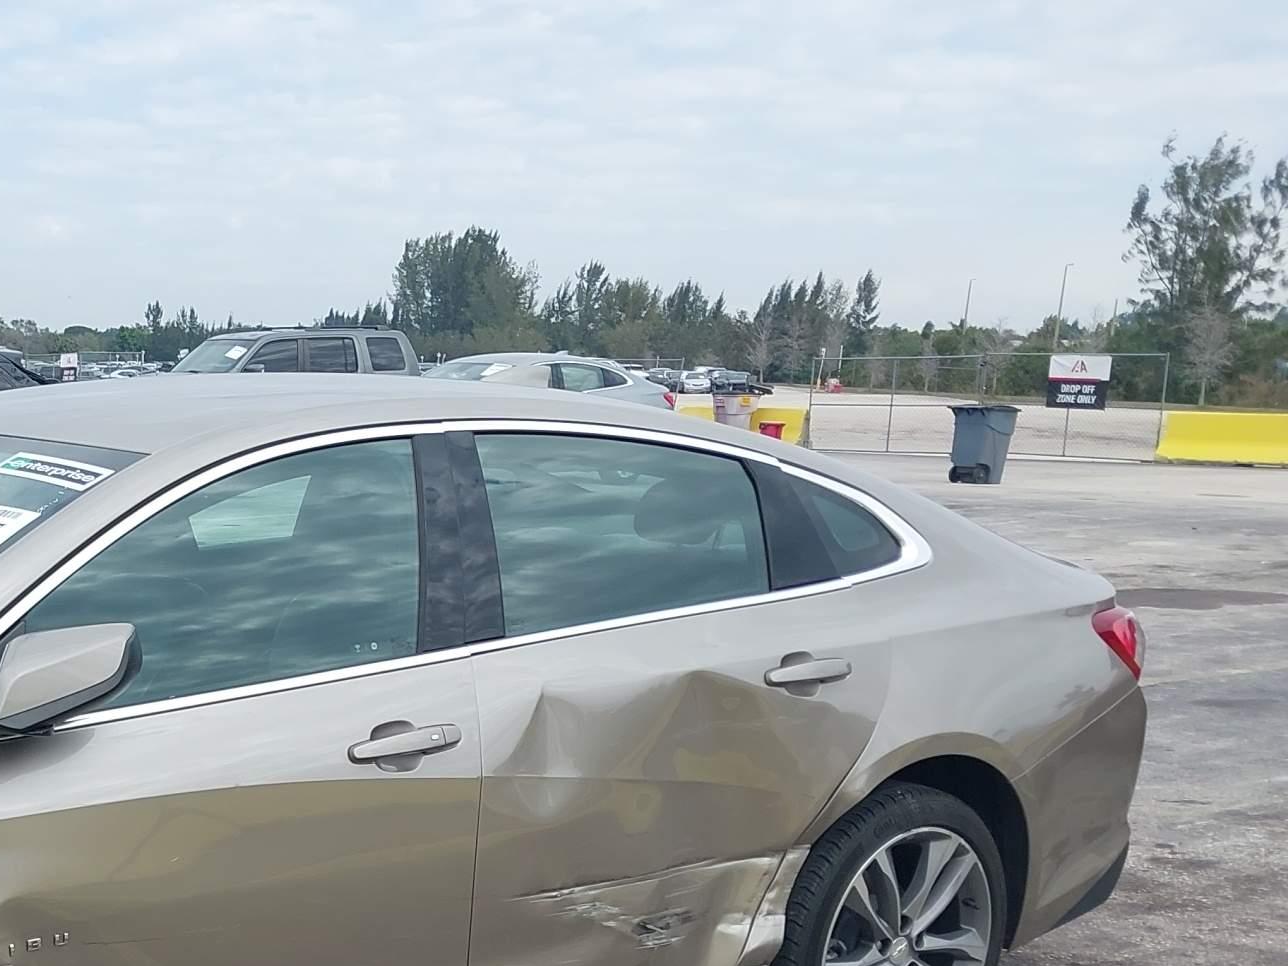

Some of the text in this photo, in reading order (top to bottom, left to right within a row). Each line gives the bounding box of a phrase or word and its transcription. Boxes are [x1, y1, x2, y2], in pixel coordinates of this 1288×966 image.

[1060, 384, 1096, 394] DROP OFF
[1056, 394, 1097, 404] ZONE ONLY
[9, 458, 96, 482] enterprise
